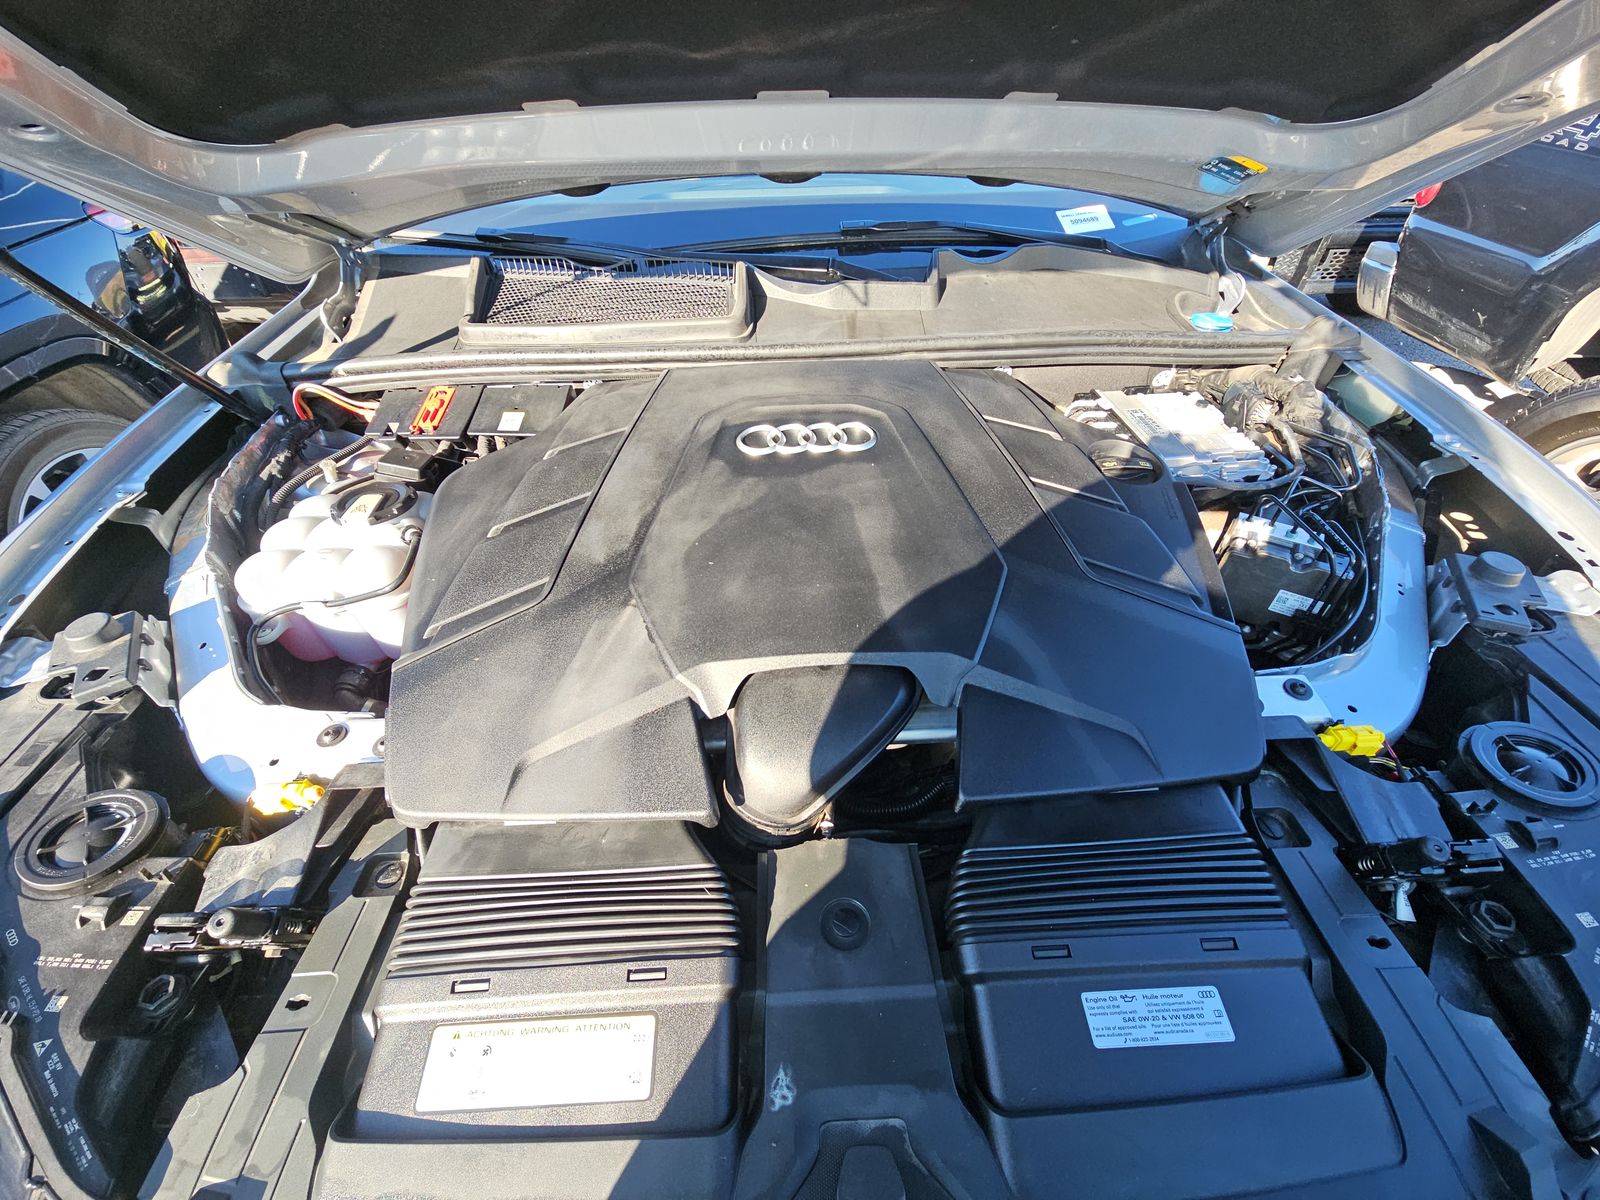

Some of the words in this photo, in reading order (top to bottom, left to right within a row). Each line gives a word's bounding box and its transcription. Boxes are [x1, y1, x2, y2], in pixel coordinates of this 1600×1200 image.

[1540, 134, 1589, 151] OAD
[1085, 996, 1107, 1004] Engine
[466, 1029, 514, 1038] ACHTUNG
[520, 1025, 569, 1036] WARNING
[575, 1022, 632, 1033] ATTENTION
